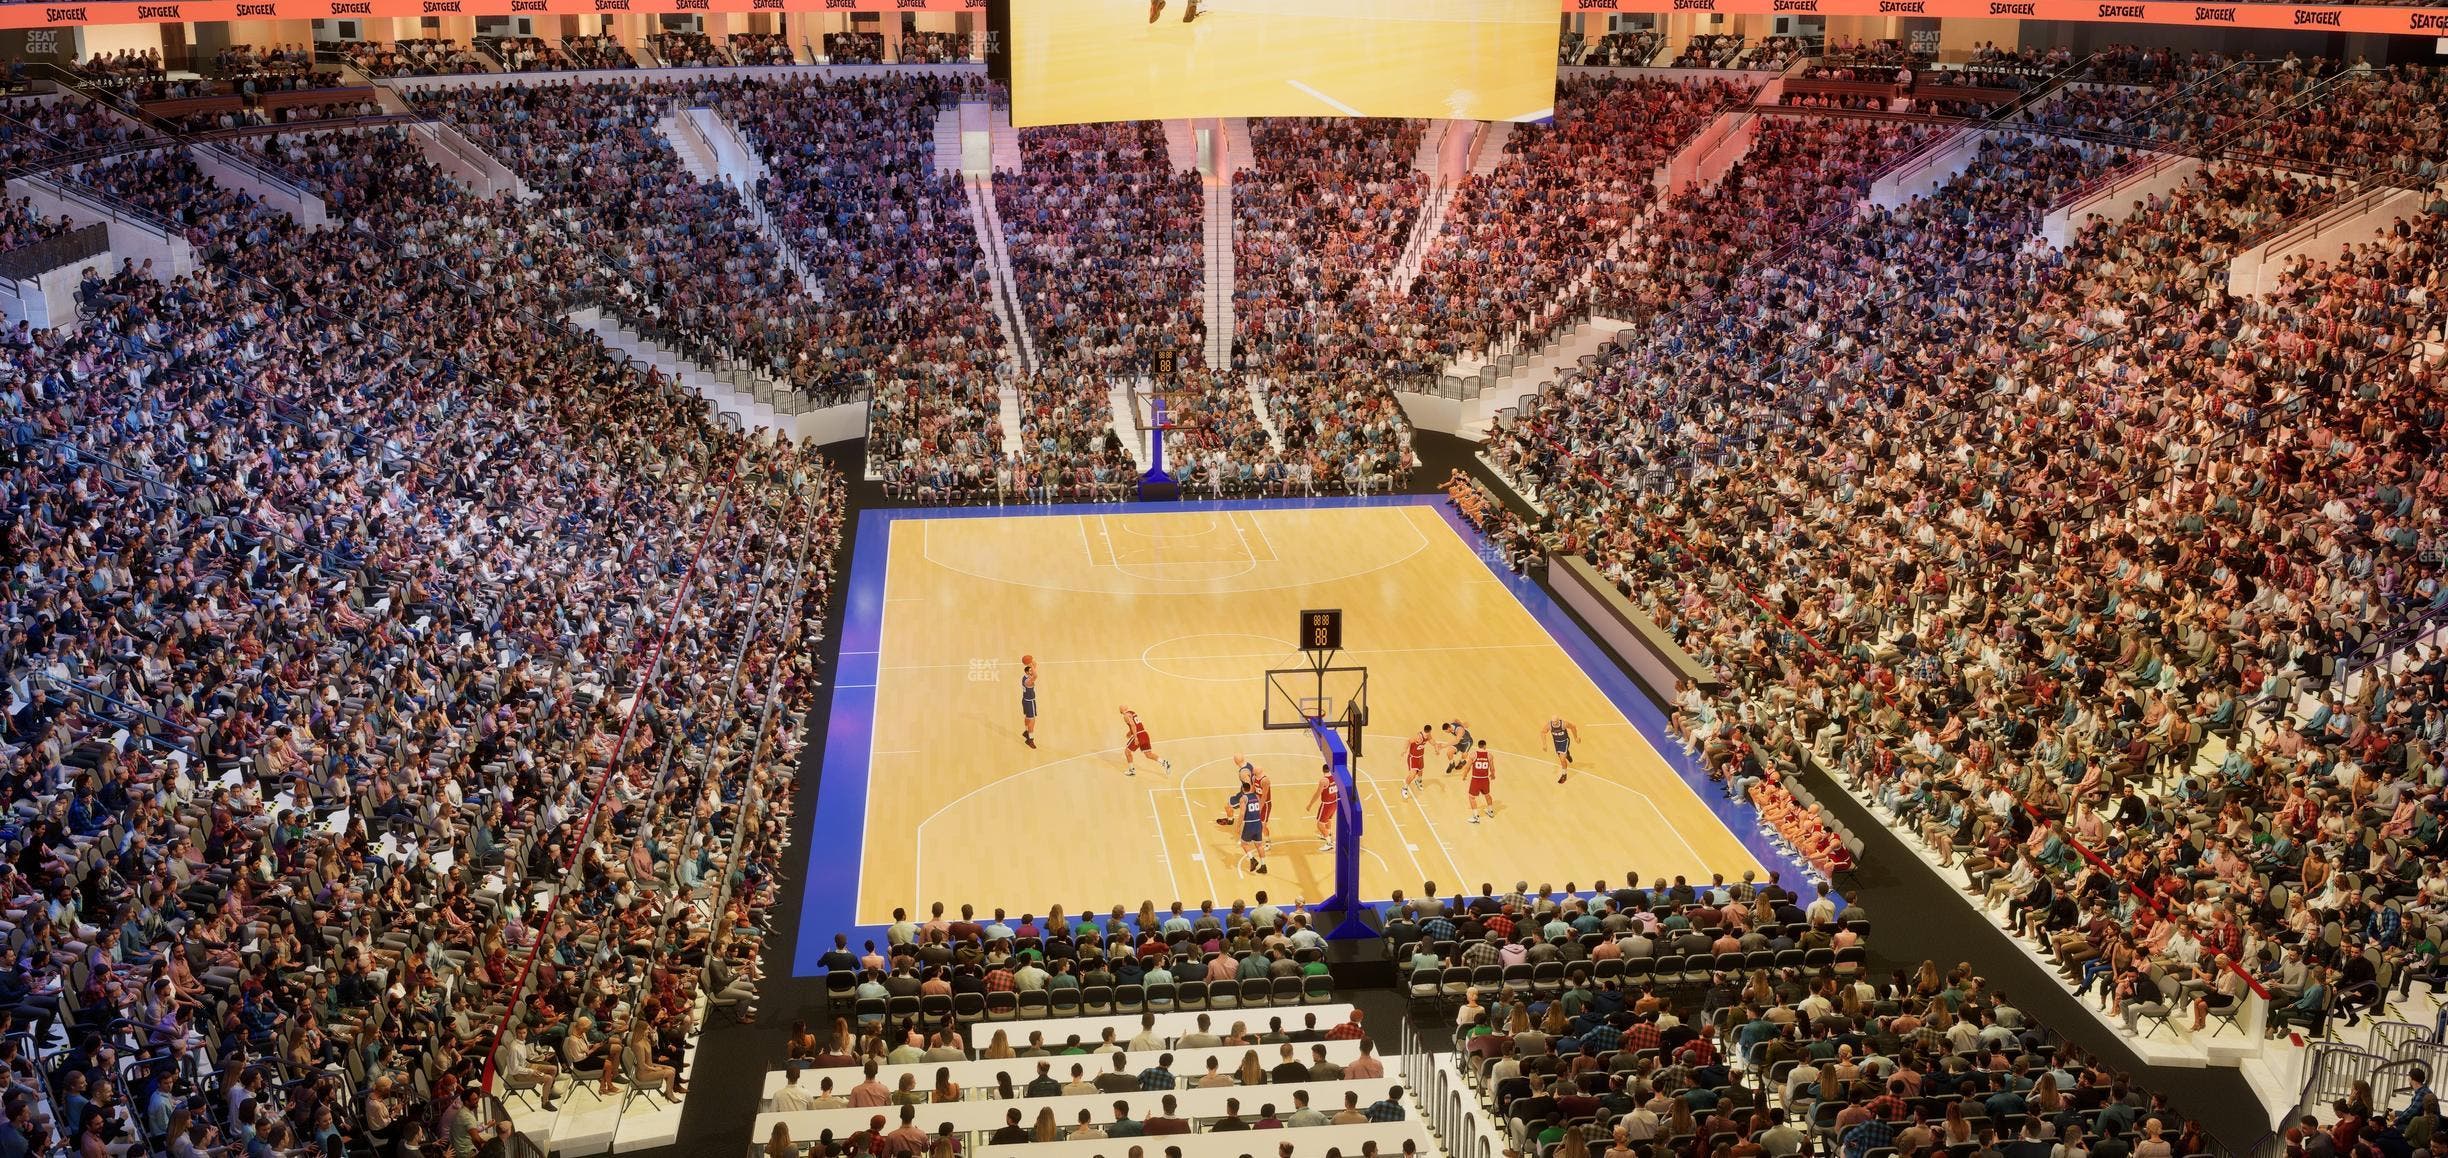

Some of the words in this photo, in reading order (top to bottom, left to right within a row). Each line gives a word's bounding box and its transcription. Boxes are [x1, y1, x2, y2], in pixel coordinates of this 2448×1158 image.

[236, 4, 276, 16] SEATGEEK
[331, 2, 371, 14] SEATGEEK
[423, 1, 461, 13] SEATGEEK
[511, 0, 548, 11] SEATGEEK
[595, 0, 631, 10] SEATGEEK
[676, 0, 710, 9] SEATGEEK
[753, 0, 785, 9] SEATGEEK
[826, 0, 857, 8] SEATGEEK
[896, 0, 927, 8] SEATGEEK
[1578, 0, 1618, 9] SEATGEEK
[1674, 0, 1715, 10] SEATGEEK
[1774, 0, 1817, 11] SEATGEEK
[1879, 1, 1925, 13] SEATGEEK
[1990, 2, 2035, 15] SEATGEEK
[47, 7, 87, 22] SEATGEEK
[138, 5, 180, 19] SEATGEEK
[2099, 5, 2145, 18] SEATGEEK
[2195, 7, 2236, 22] SEATGEEK
[2294, 10, 2342, 26] SEATGEEK
[2410, 13, 2448, 29] SEATGE
[1247, 802, 1260, 812] 00
